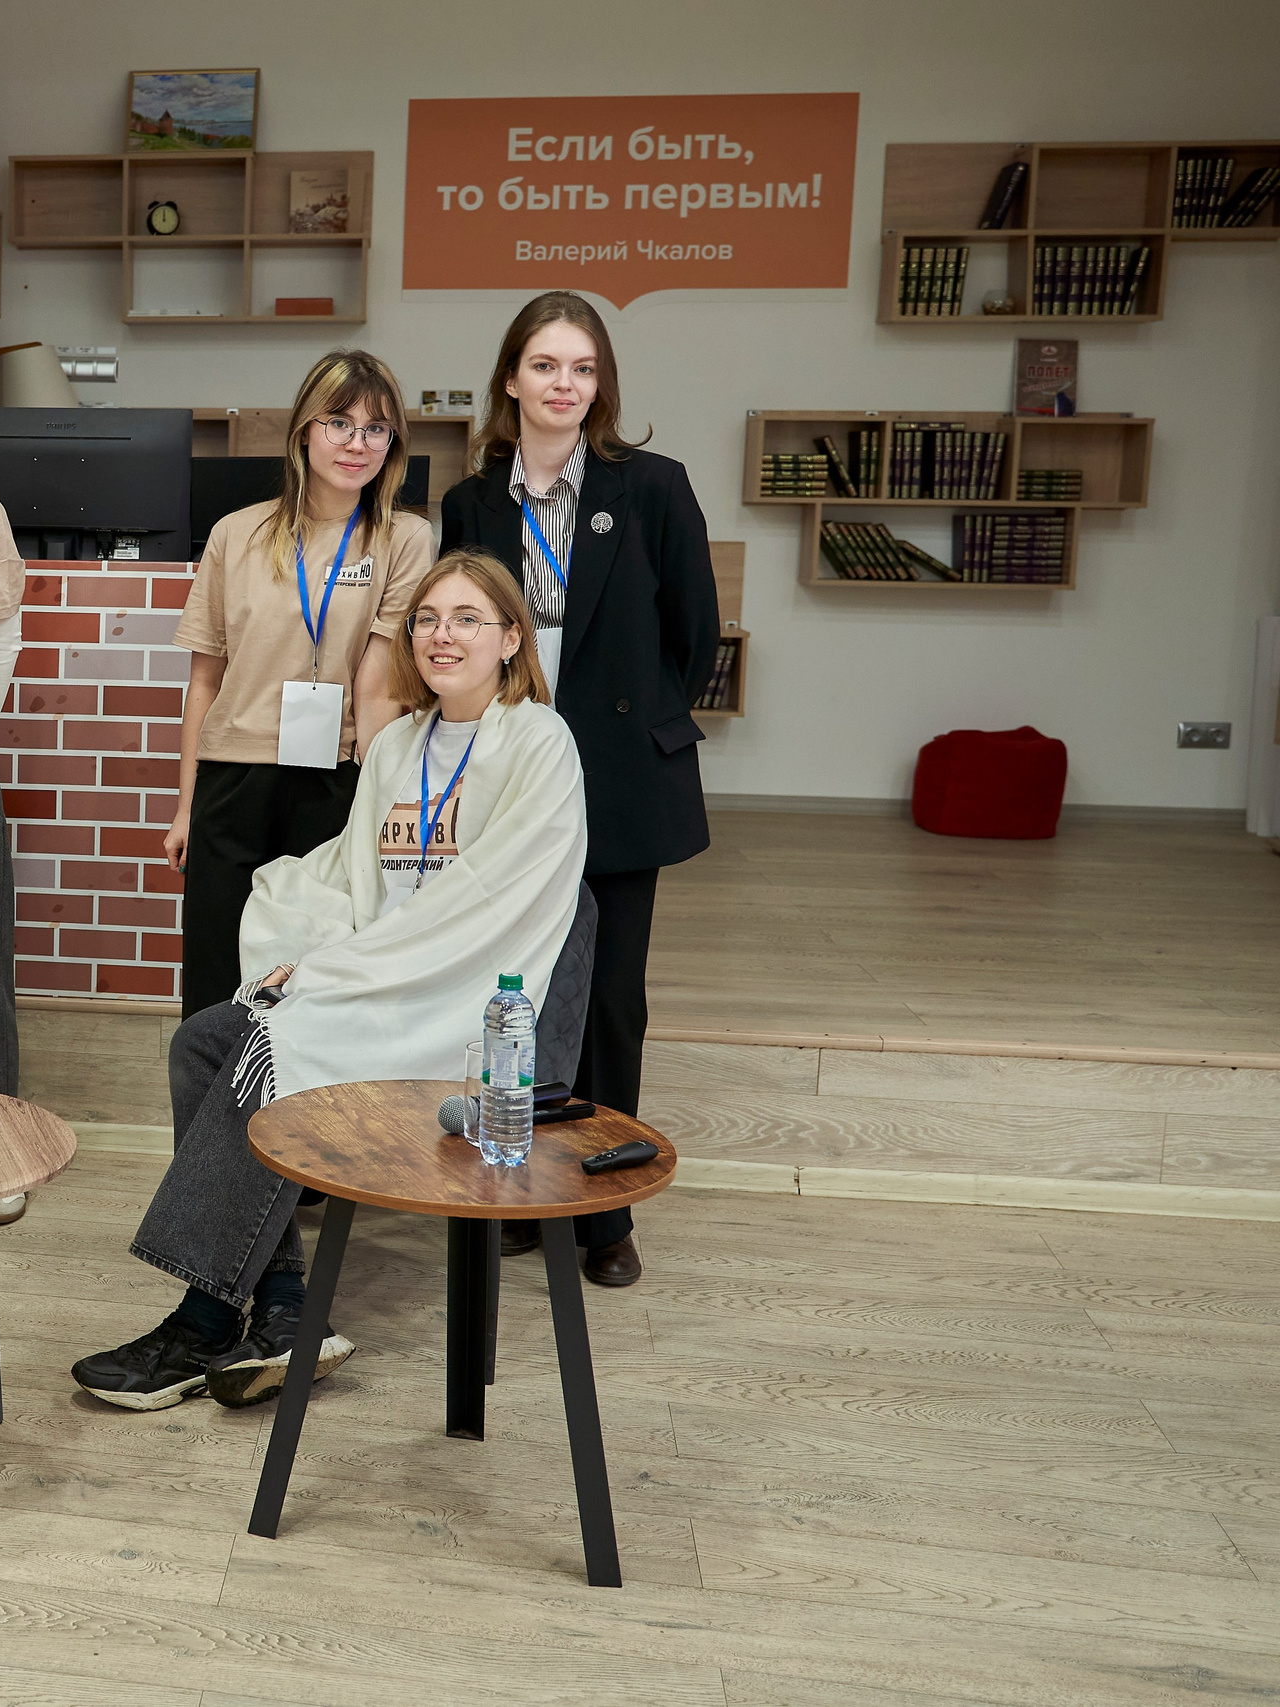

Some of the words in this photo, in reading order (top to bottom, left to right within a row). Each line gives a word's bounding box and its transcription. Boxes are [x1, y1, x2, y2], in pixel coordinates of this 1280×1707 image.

[507, 127, 613, 162] Если
[628, 126, 754, 166] быть,
[437, 186, 484, 211] то
[498, 176, 610, 211] быть
[624, 174, 822, 218] первым!
[515, 240, 628, 266] Валерий
[637, 240, 733, 261] Чкалов
[46, 422, 77, 430] PHILIPS
